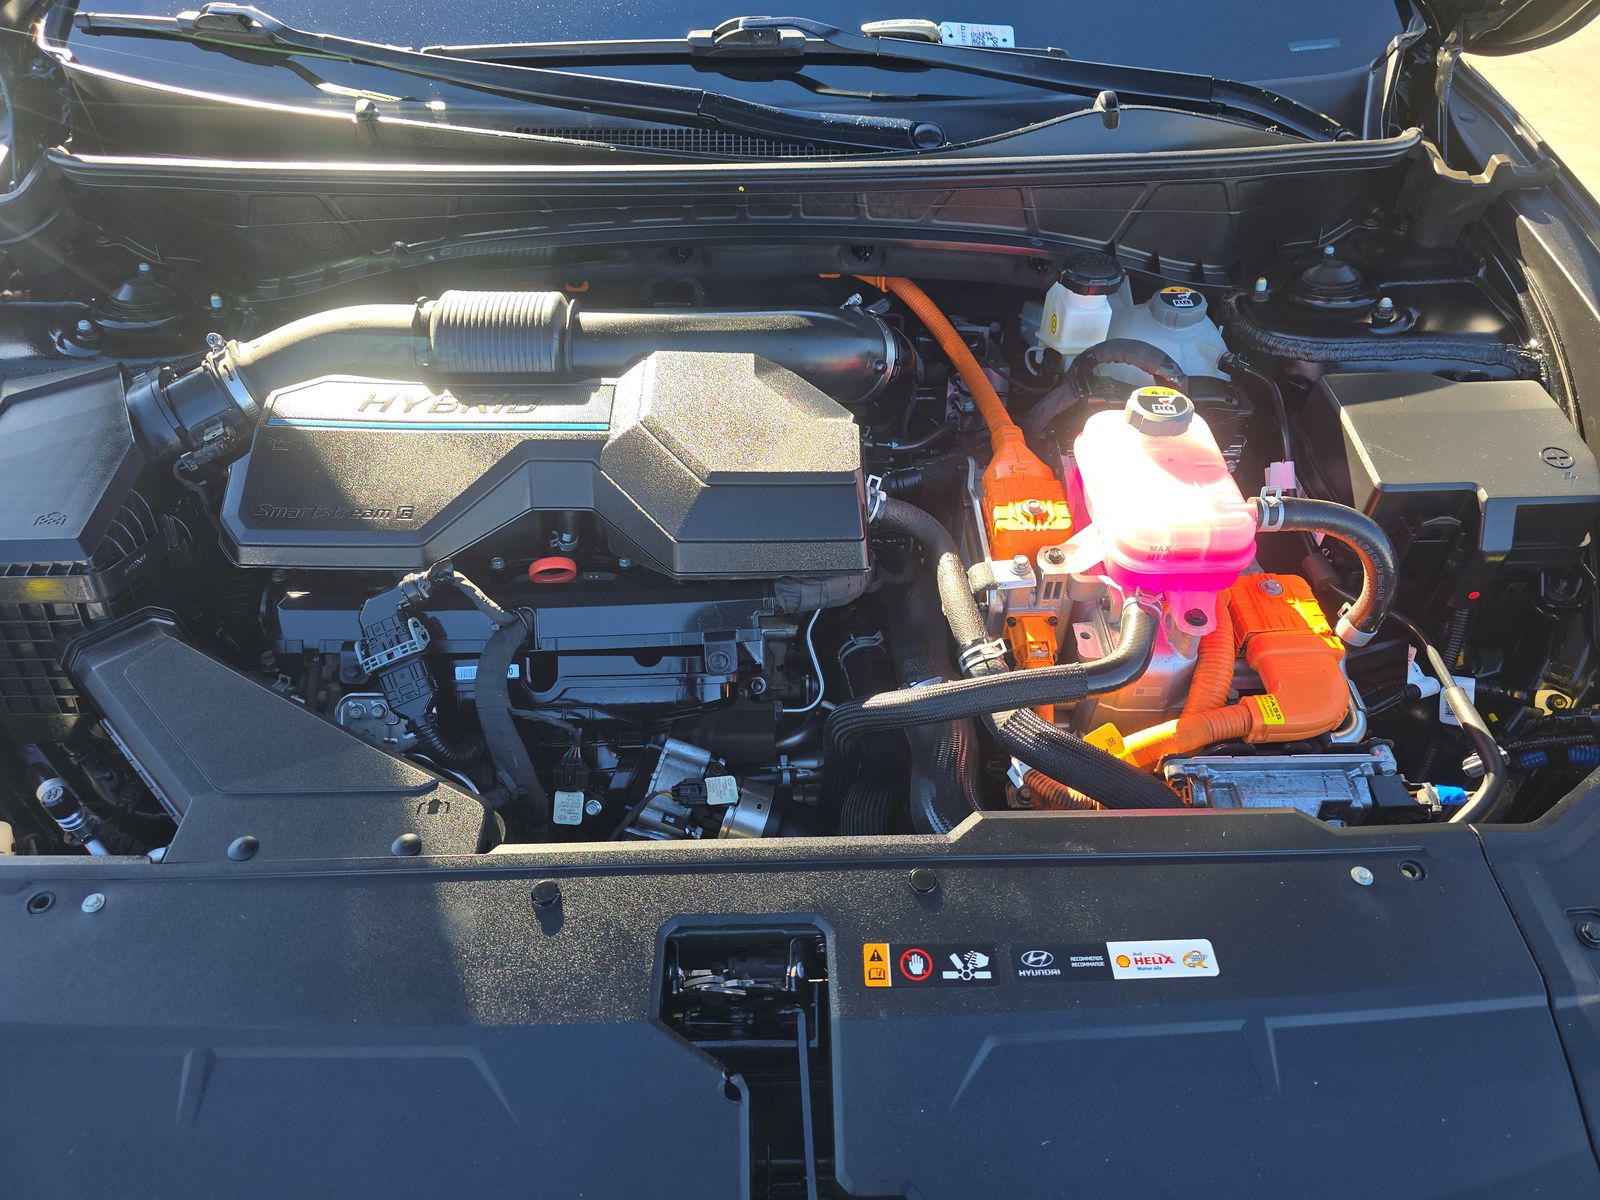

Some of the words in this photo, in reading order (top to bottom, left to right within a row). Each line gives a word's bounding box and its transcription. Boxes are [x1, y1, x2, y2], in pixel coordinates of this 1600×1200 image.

[357, 392, 542, 414] HYBRID
[396, 505, 415, 521] G
[1267, 695, 1282, 720] PASS
[1133, 954, 1176, 965] HELIX
[1018, 969, 1061, 977] HYUNDAI
